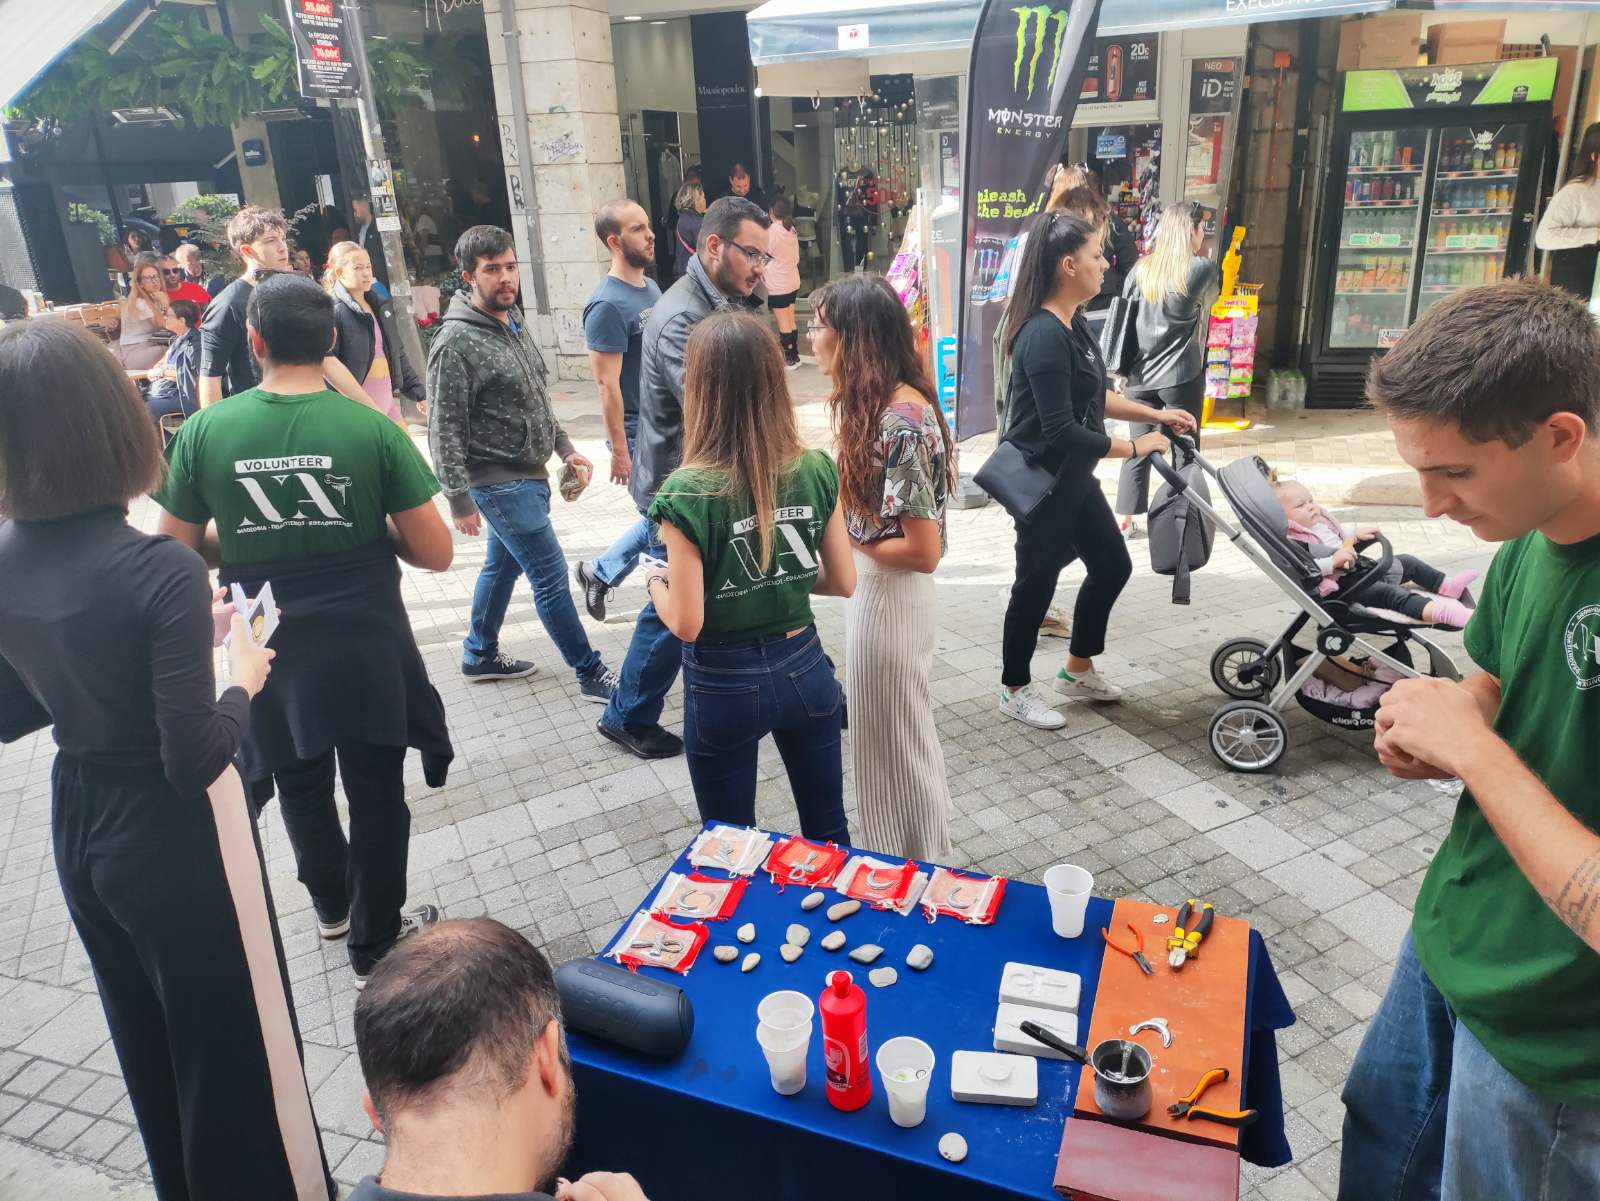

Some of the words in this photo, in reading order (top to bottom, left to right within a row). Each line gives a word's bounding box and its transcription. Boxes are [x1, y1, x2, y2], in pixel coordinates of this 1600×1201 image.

[1226, 0, 1323, 11] EXECU
[1204, 61, 1223, 70] NEO
[987, 107, 1063, 129] MONSTER
[996, 126, 1052, 139] ENERGY
[243, 457, 324, 471] VOLUNTEER
[741, 508, 804, 530] VOEER
